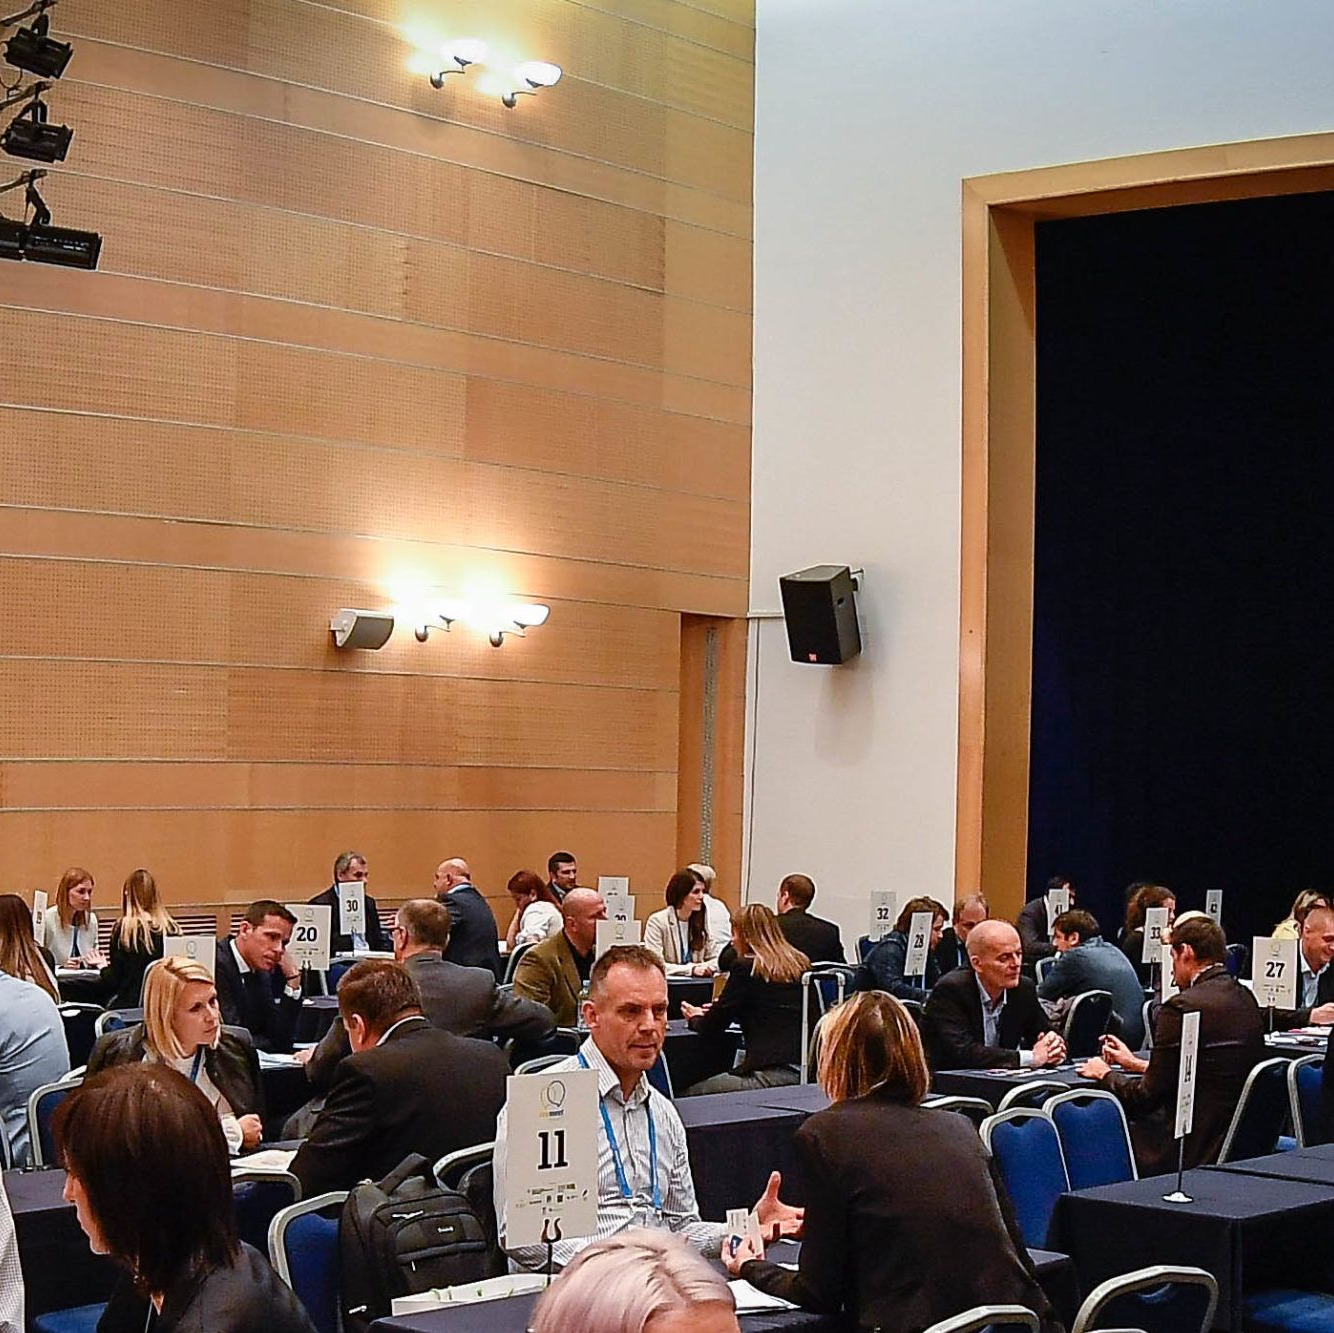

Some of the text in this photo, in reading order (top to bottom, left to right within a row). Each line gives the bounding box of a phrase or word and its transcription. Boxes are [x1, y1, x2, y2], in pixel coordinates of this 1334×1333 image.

[346, 899, 359, 913] 30
[876, 907, 889, 920] 32
[296, 926, 318, 942] 20
[1265, 961, 1286, 979] 27
[537, 1129, 569, 1170] 11
